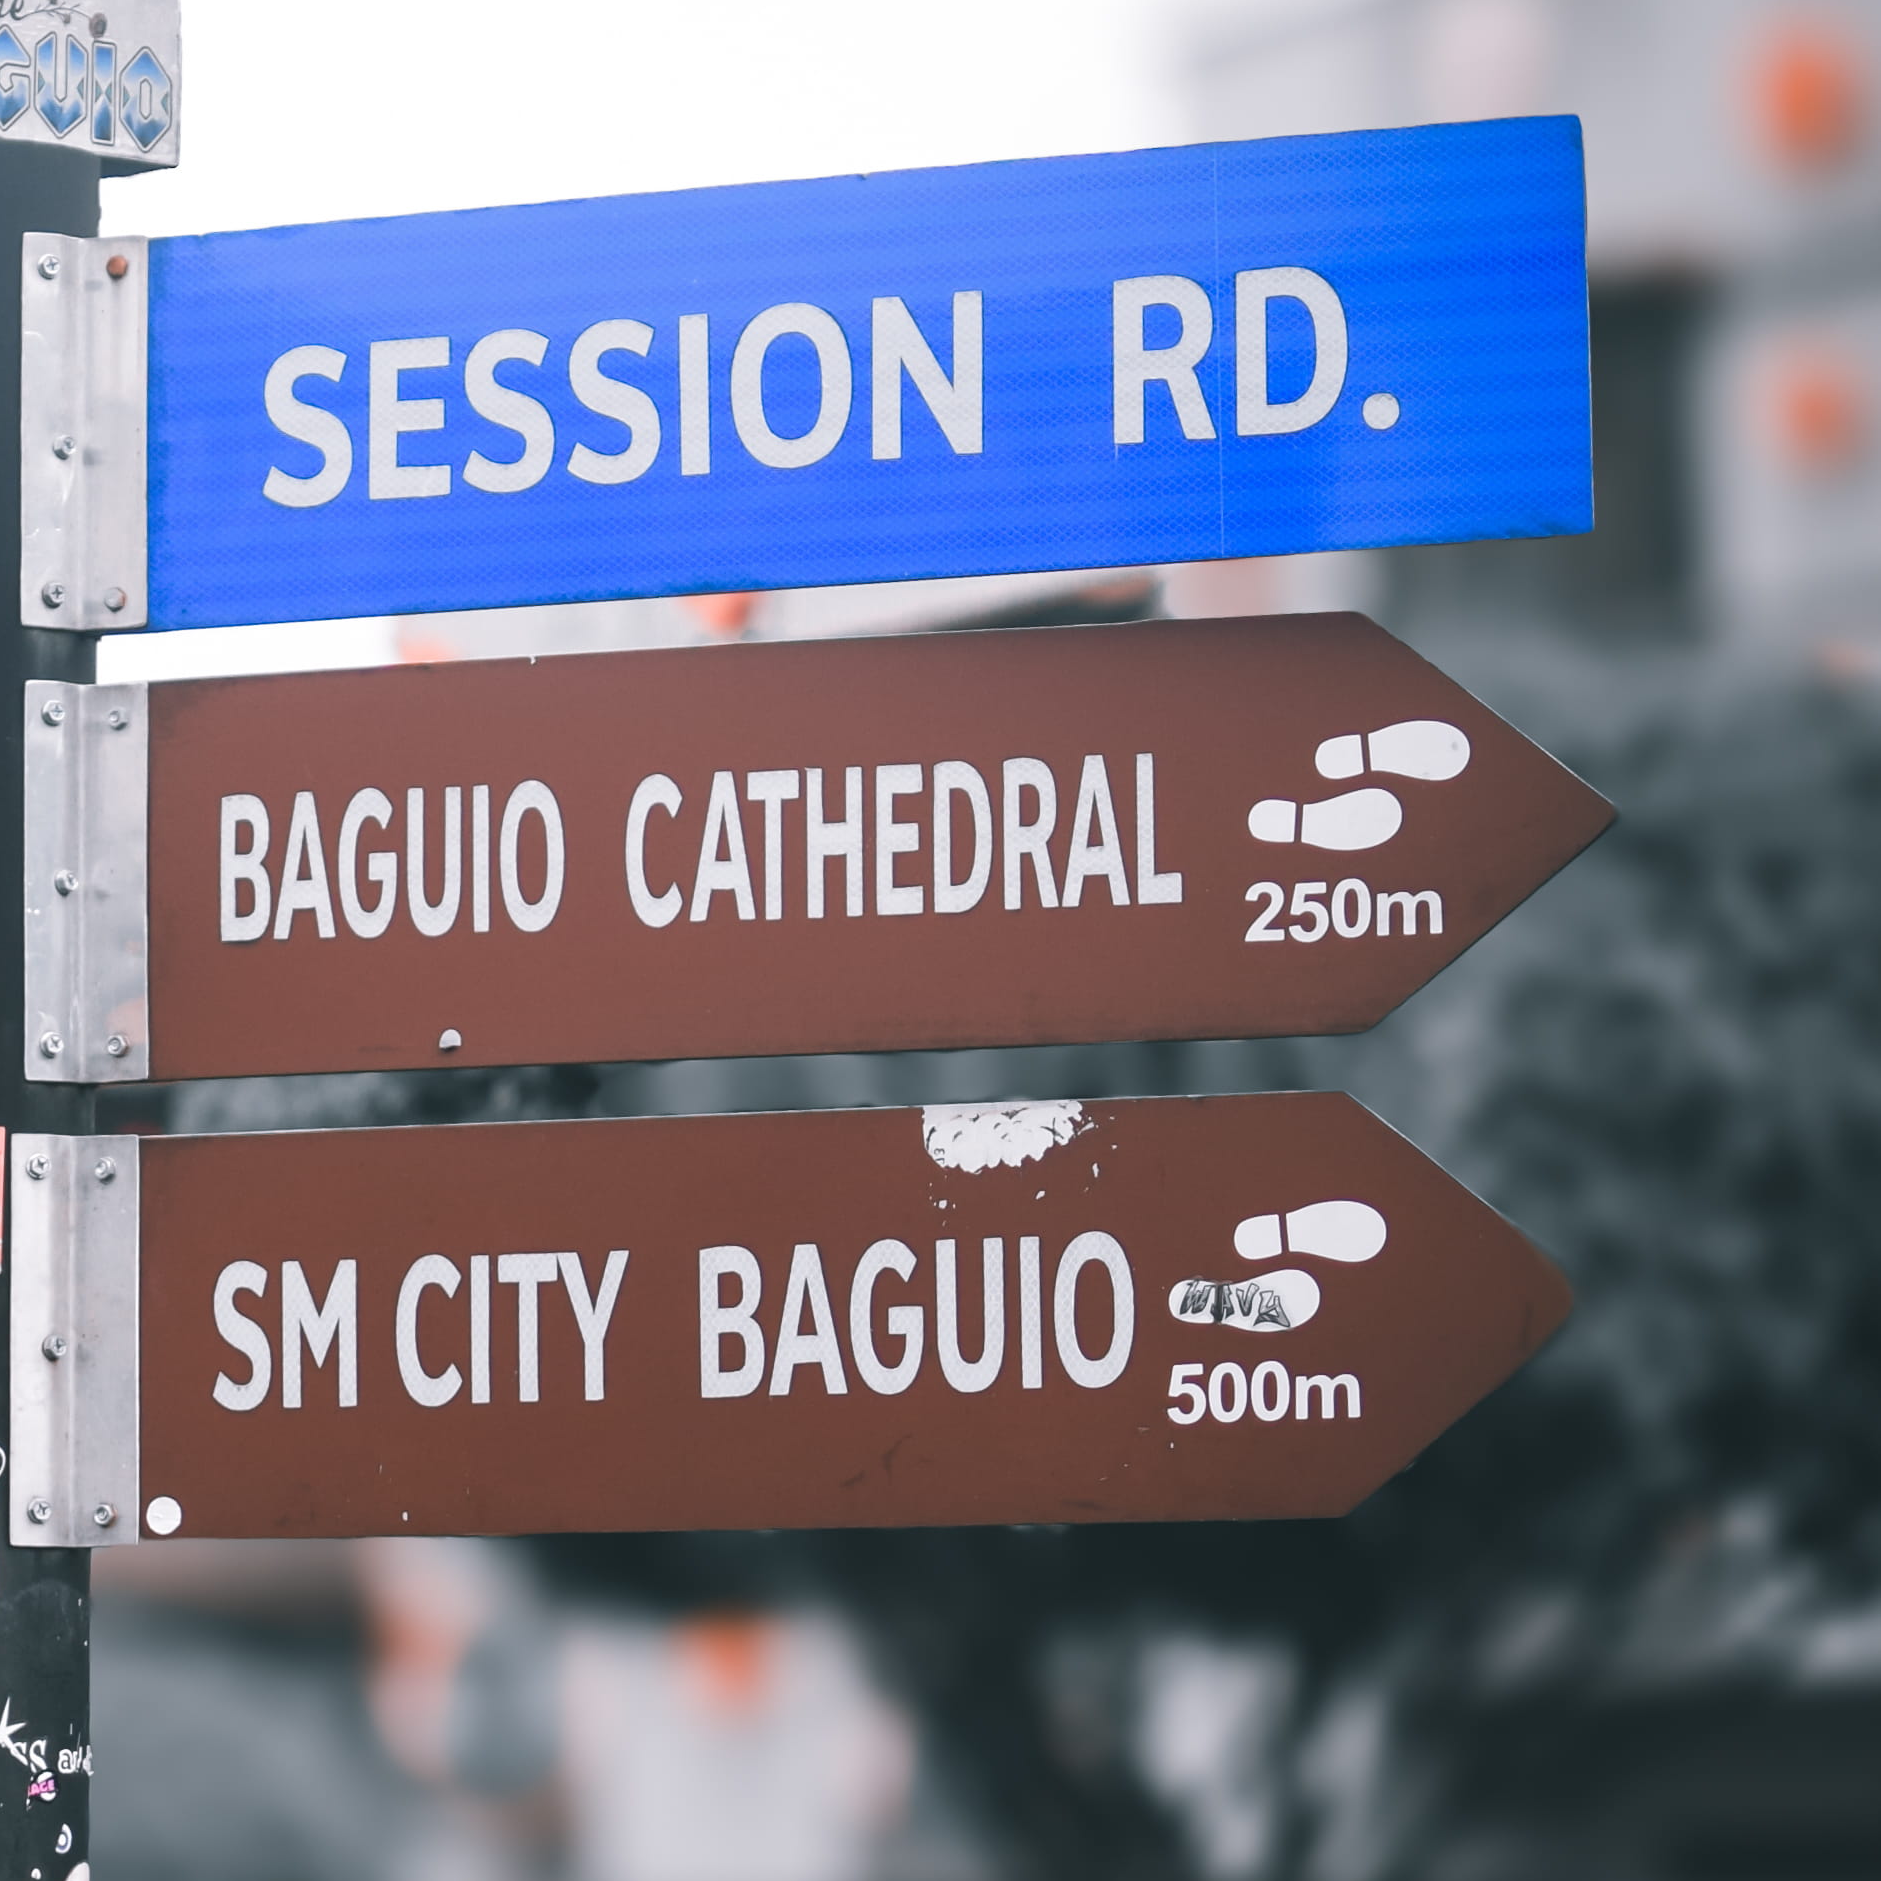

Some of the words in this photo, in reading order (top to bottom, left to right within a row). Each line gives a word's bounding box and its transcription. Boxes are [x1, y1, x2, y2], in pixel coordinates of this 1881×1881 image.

[262, 290, 984, 508] SESSION
[1113, 265, 1401, 446] RD.
[219, 779, 566, 942] BAGUIO
[624, 752, 1183, 928] CATHEDRAL
[1244, 878, 1444, 943] 250m
[212, 1259, 358, 1412] SM
[395, 1249, 630, 1407] CITY
[699, 1230, 1136, 1400] BAGUIO
[1167, 1360, 1361, 1425] 500m
